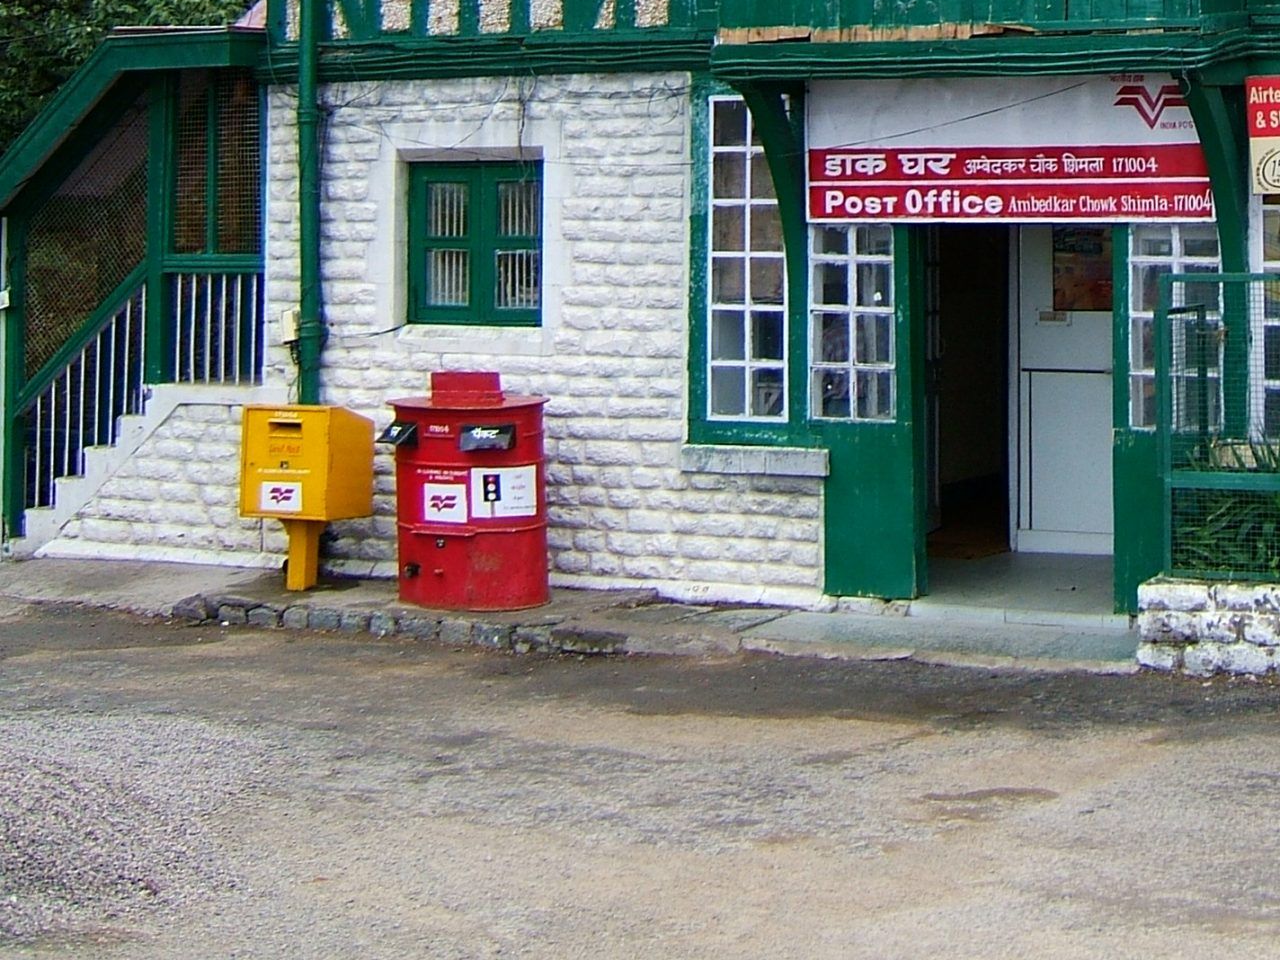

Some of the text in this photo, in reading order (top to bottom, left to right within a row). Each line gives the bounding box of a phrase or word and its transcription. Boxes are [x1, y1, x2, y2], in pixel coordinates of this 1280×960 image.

[1256, 111, 1267, 129] &
[825, 153, 887, 176] डाक
[897, 153, 957, 175] घर
[1112, 156, 1159, 173] 171004
[905, 189, 1003, 214] Office
[1008, 195, 1076, 213] Ambedkar
[1079, 195, 1118, 212] Chowk
